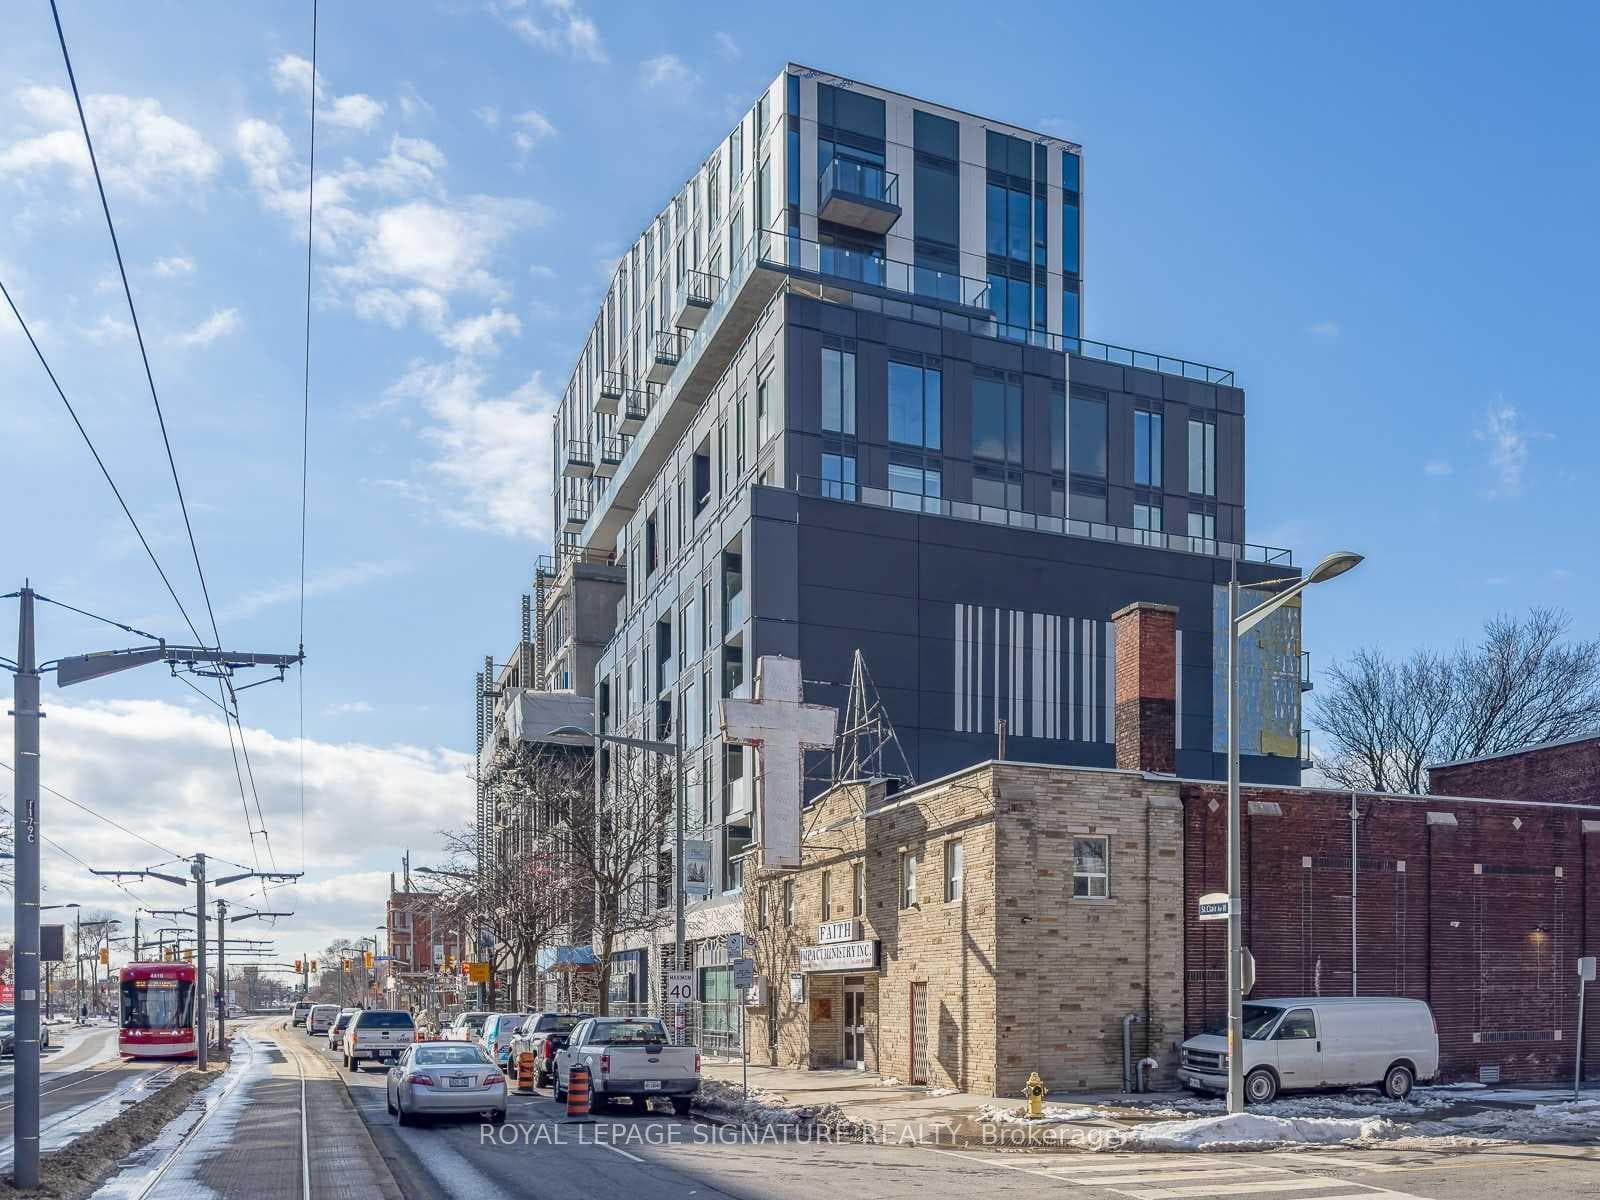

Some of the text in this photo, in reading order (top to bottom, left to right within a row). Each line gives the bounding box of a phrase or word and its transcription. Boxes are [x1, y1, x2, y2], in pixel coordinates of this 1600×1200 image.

[820, 923, 851, 940] FAITH
[800, 946, 824, 962] IMPACT
[824, 944, 856, 960] MINISTRY
[670, 984, 692, 999] 40
